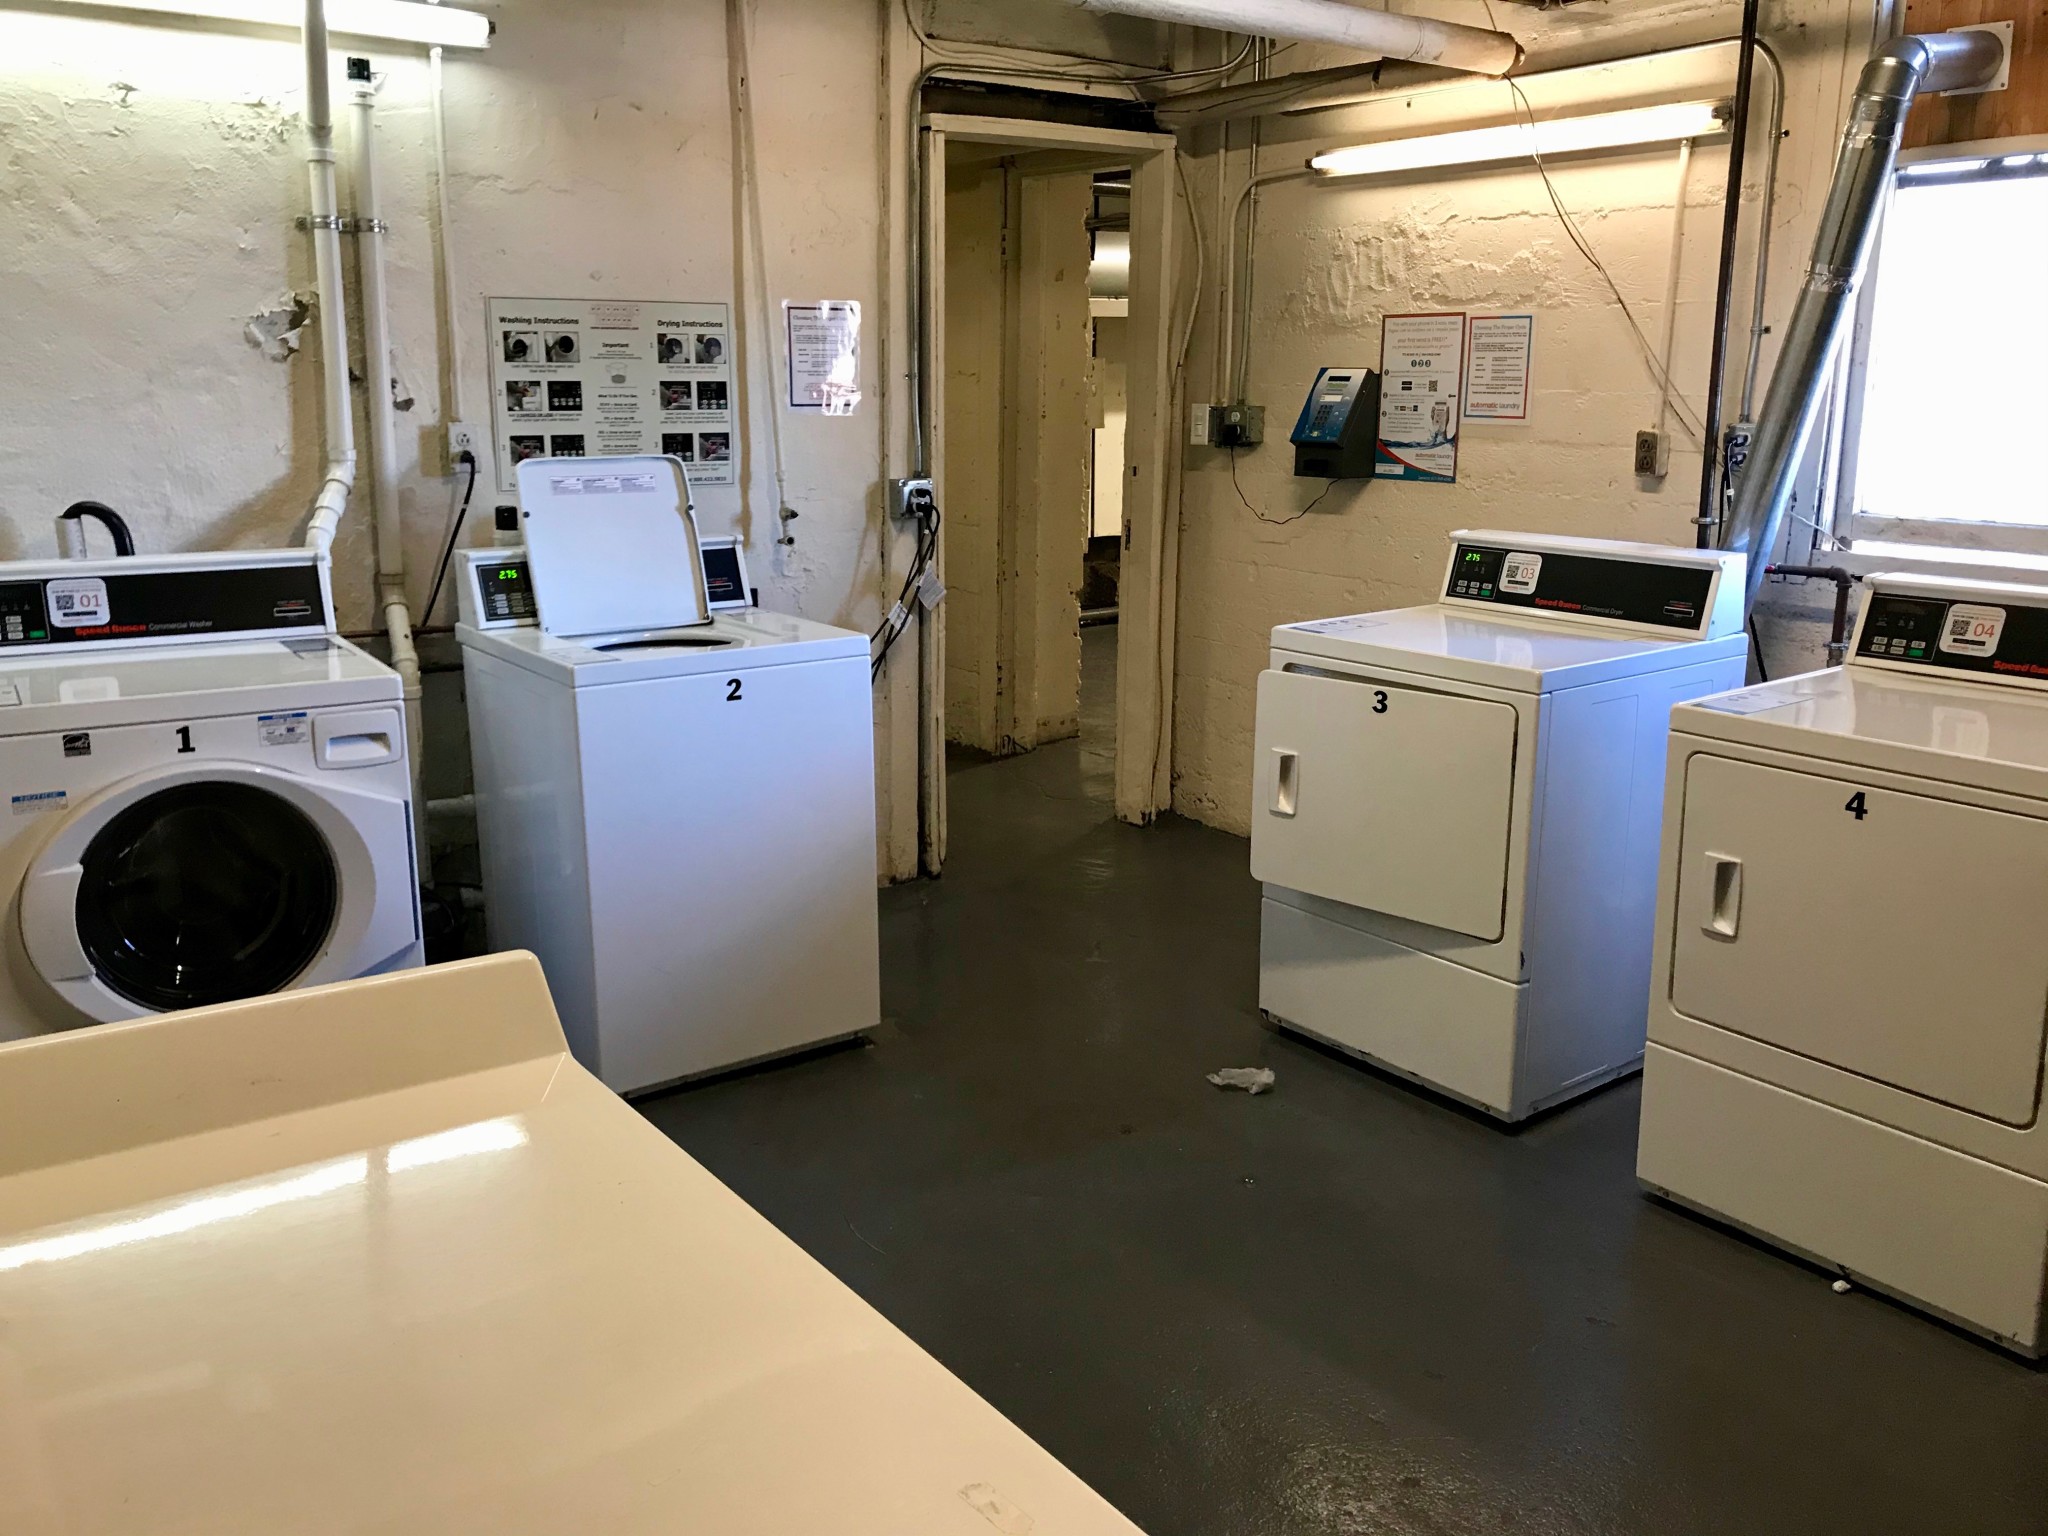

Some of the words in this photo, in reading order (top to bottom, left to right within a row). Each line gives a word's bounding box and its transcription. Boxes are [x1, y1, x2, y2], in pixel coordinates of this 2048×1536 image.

[499, 316, 532, 325] Washing
[533, 316, 579, 325] Instructions
[657, 319, 680, 328] Drying
[682, 320, 723, 328] Instructions
[1499, 402, 1520, 410] laundry
[1521, 567, 1535, 580] 03
[80, 594, 102, 608] 01
[1534, 597, 1558, 607] Speed
[1558, 600, 1582, 610] Queen
[1582, 604, 1609, 614] Commercial
[1610, 608, 1624, 616] Dryer
[75, 625, 110, 637] Speed
[149, 621, 188, 631] Commercial
[189, 620, 212, 628] Washer
[1973, 623, 1995, 638] 04
[1993, 661, 2030, 672] Speed
[726, 678, 742, 701] 2
[1372, 690, 1388, 714] 3
[176, 725, 196, 753] 1
[1845, 791, 1868, 821] 4
